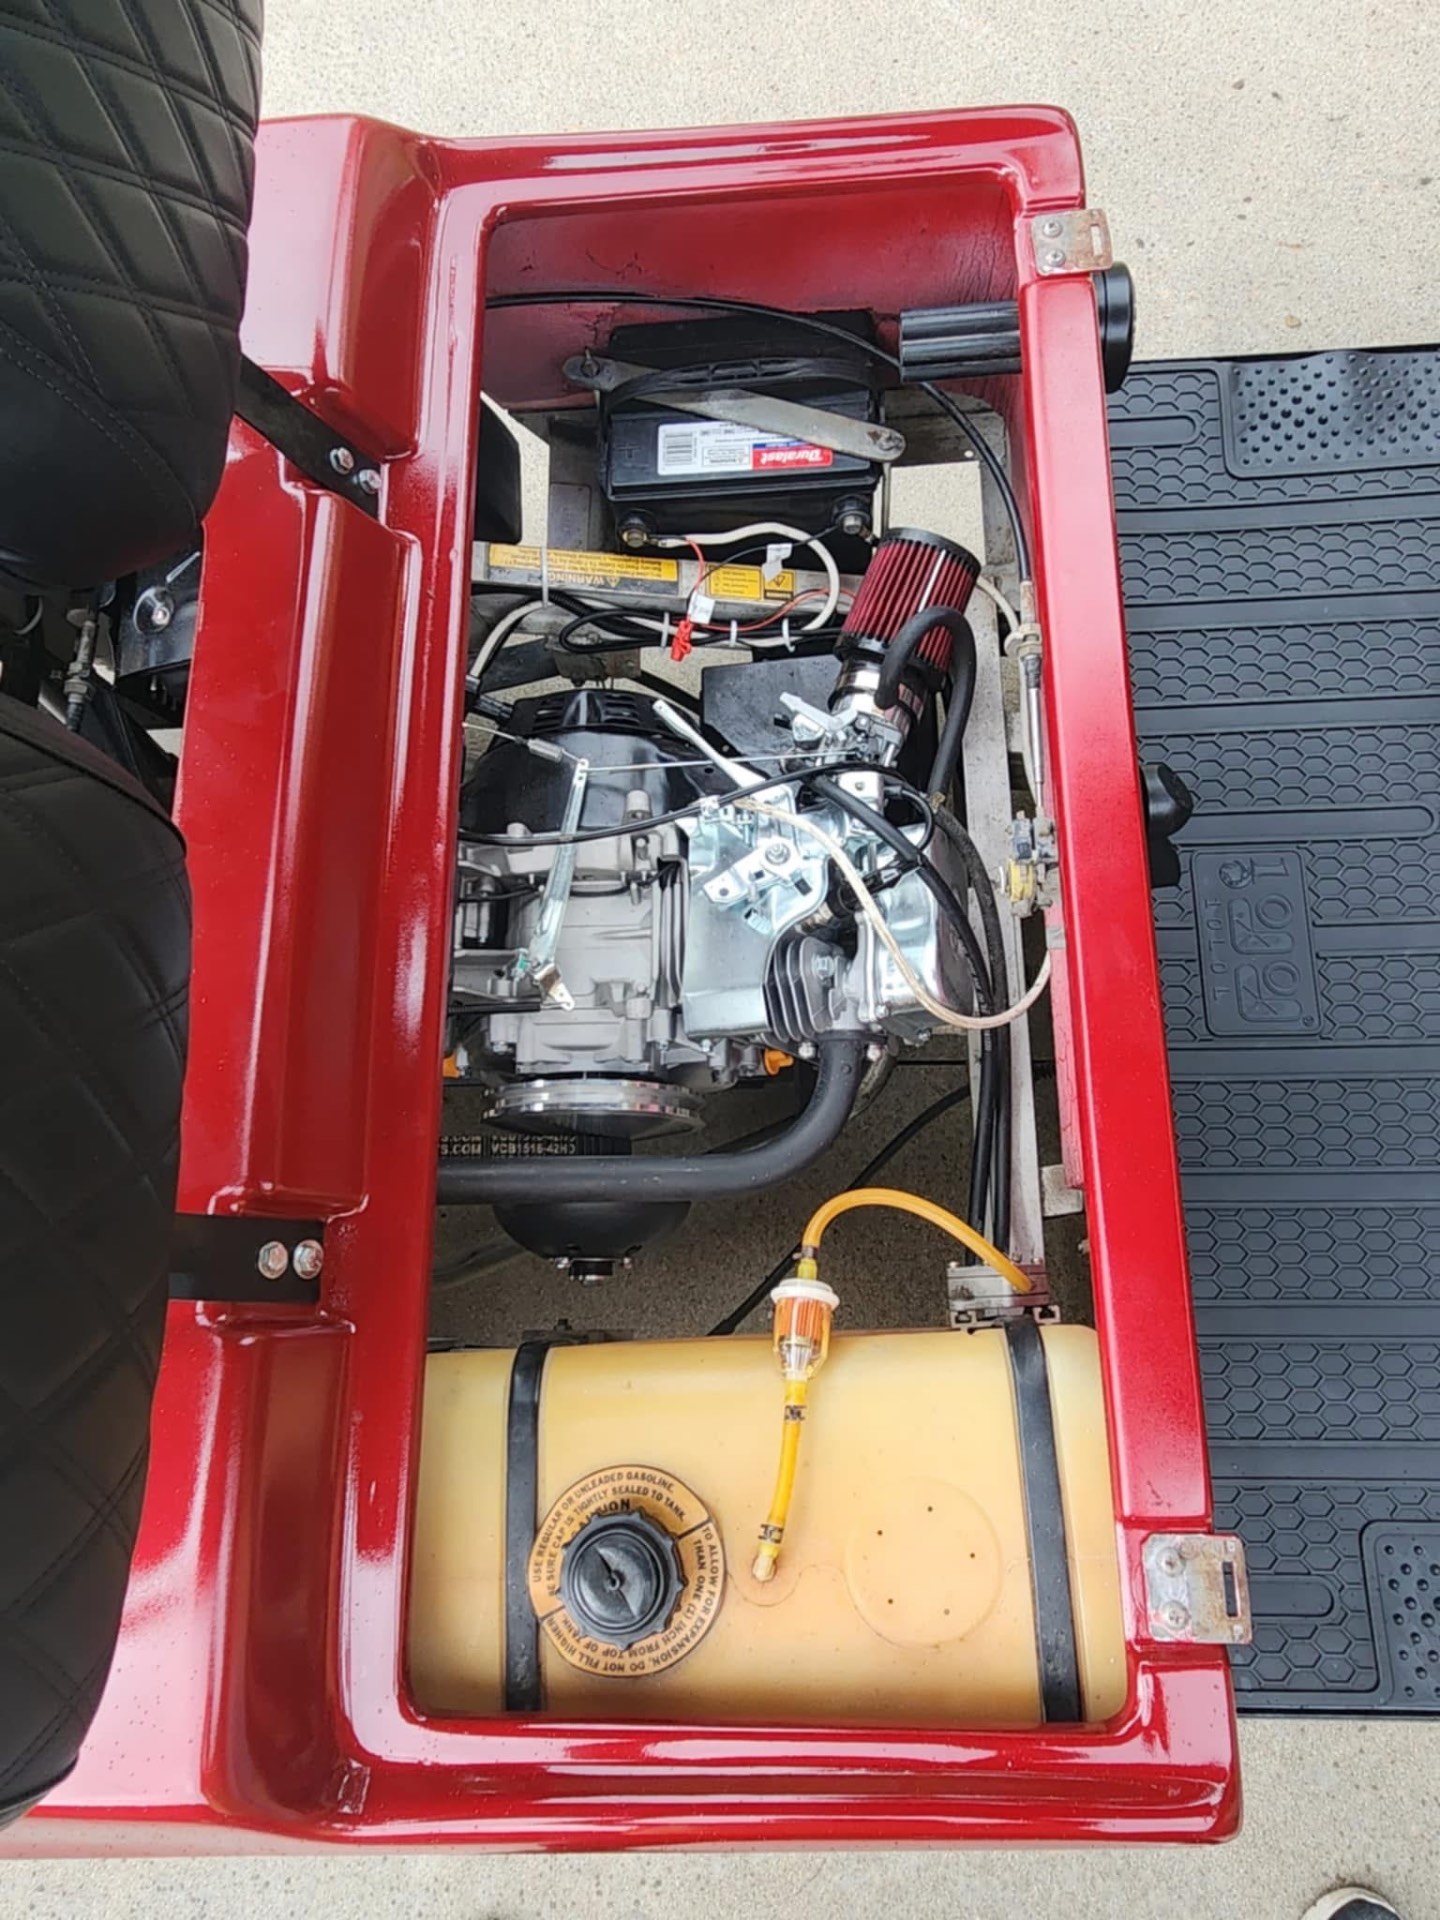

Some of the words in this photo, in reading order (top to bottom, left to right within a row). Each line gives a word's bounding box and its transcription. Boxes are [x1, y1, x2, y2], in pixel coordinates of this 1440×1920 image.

[761, 448, 823, 464] Duralast
[549, 571, 606, 586] WARNING
[575, 1472, 623, 1499] UNLEADED
[562, 1496, 575, 1511] OR
[536, 1511, 564, 1557] REGULAR
[545, 1551, 556, 1581] SURE
[552, 1527, 565, 1549] CAP
[565, 1514, 574, 1526] IS
[574, 1491, 607, 1516] TIGHTLY
[611, 1485, 649, 1496] SEALED
[651, 1489, 664, 1502] TO
[702, 1526, 714, 1541] TO
[693, 1539, 706, 1569] THAN
[533, 1558, 542, 1582] USE
[708, 1544, 720, 1587] ALLOW
[693, 1575, 705, 1601] ONE
[701, 1589, 716, 1616] FOR
[546, 1618, 577, 1656] HIGHER
[661, 1620, 686, 1645] INCH
[584, 1640, 599, 1653] OF
[601, 1646, 624, 1659] TOP
[628, 1642, 661, 1657] FROM
[577, 1652, 600, 1669] FILL
[602, 1660, 624, 1673] NOT
[629, 1660, 645, 1671] DO
